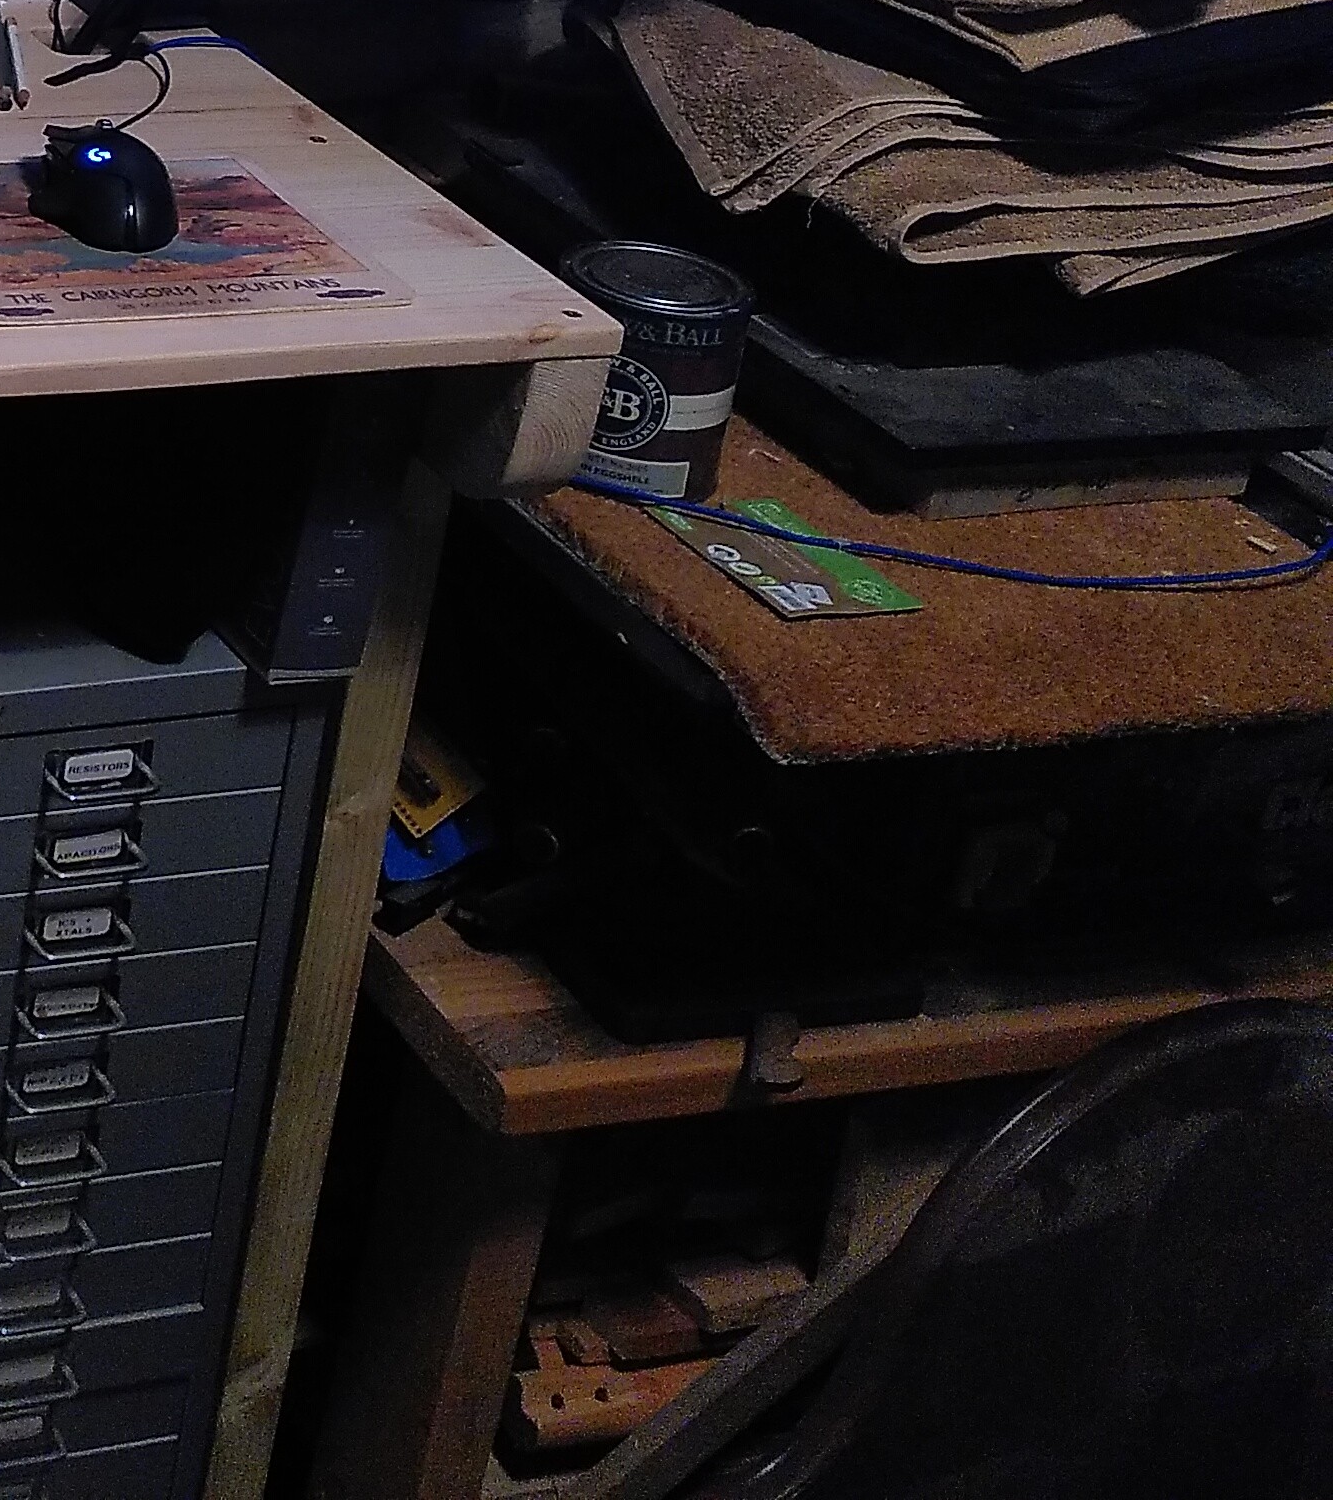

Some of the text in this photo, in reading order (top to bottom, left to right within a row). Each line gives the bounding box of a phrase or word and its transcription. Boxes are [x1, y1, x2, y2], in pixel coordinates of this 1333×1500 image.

[6, 278, 342, 305] THE CAIRNGORM MOUNTAINS
[665, 321, 724, 347] BALL
[639, 373, 664, 405] BALL
[601, 421, 658, 446] ENGLAND
[67, 761, 132, 775] RESISTORS
